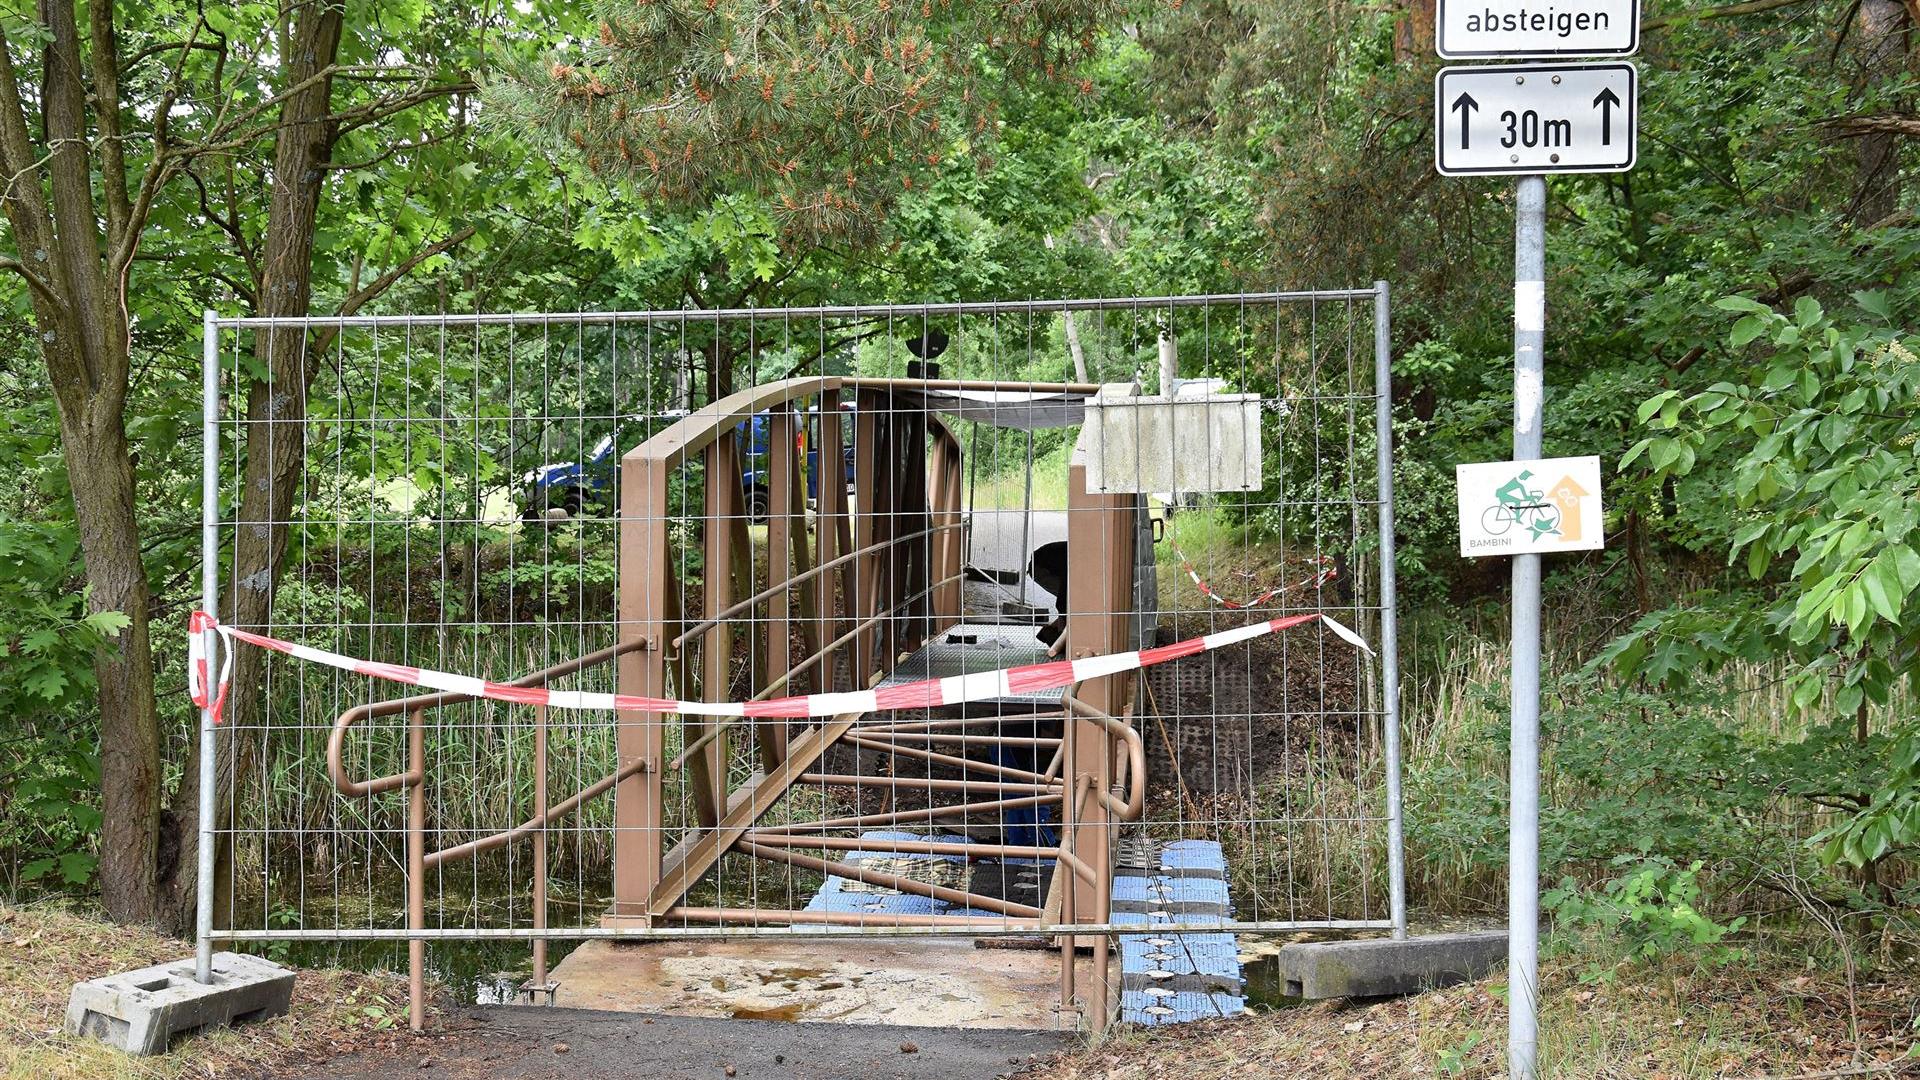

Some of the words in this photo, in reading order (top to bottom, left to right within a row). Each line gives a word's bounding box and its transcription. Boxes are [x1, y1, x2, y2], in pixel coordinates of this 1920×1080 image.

[1466, 7, 1609, 38] absteigen
[1500, 110, 1571, 149] 30m
[1469, 537, 1512, 548] BAMBINI
